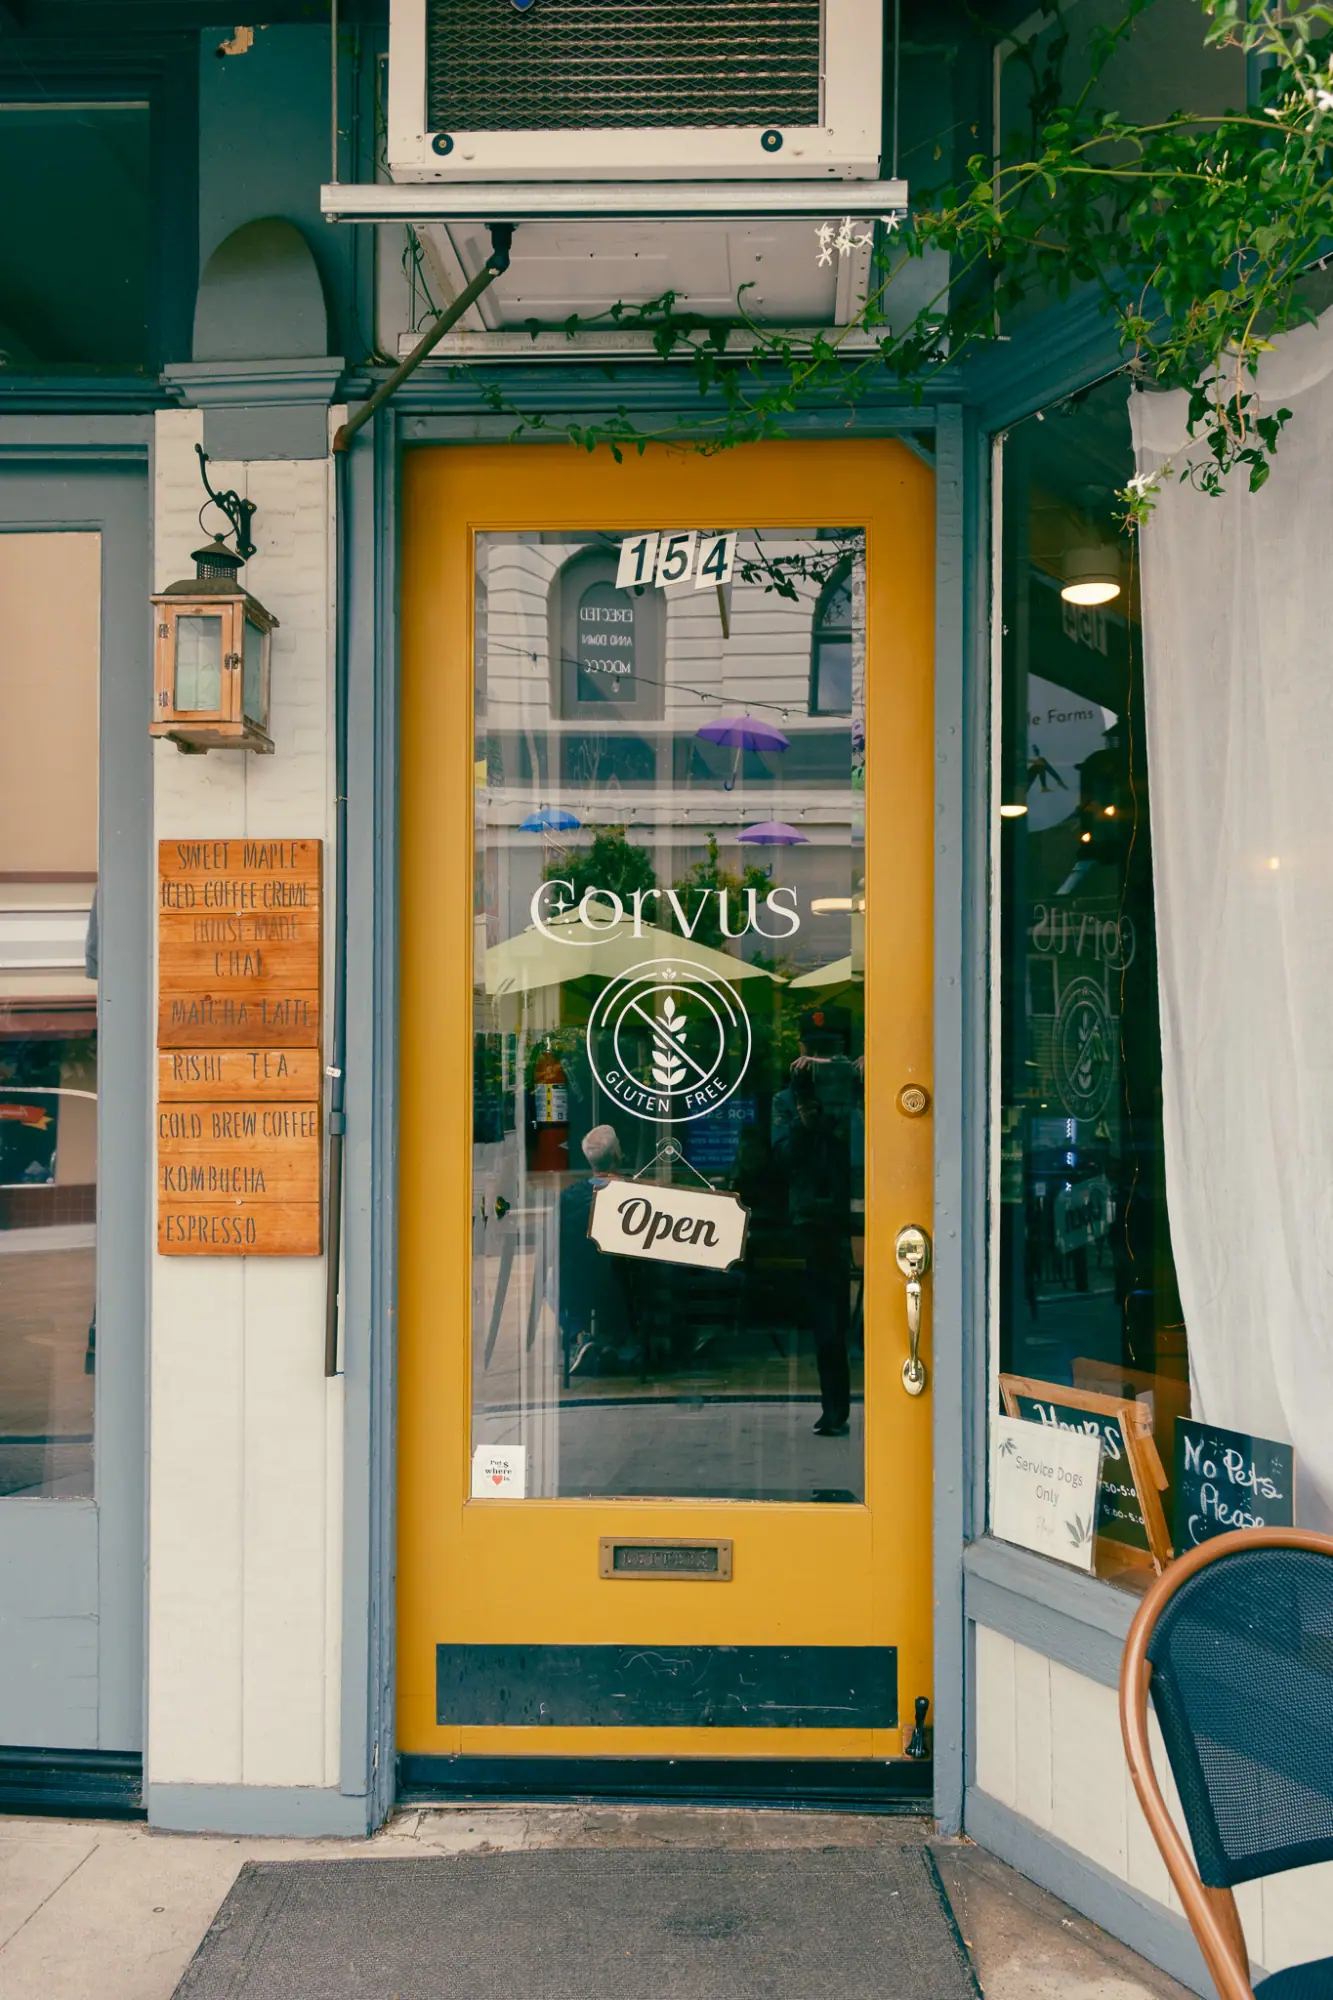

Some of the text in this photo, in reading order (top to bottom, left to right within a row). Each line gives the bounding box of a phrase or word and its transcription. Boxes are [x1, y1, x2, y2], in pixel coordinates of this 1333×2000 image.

[630, 535, 728, 582] 154
[1048, 709, 1094, 724] Farms
[177, 842, 298, 870] SWEET MAPLE
[162, 881, 309, 909] ICED COFFEE CREME
[530, 878, 800, 946] Corvus
[215, 948, 262, 977] CHAI
[172, 998, 310, 1026] MATCHA LATTE
[173, 1052, 288, 1081] RISHI TEA
[605, 1070, 670, 1112] GLUTEN
[685, 1077, 728, 1109] FREE
[159, 1111, 316, 1138] COLD BREW COFFEE
[164, 1166, 266, 1193] KOMBUCHA
[166, 1215, 256, 1245] ESPRESSO
[617, 1197, 720, 1250] Open
[1016, 1455, 1083, 1488] Service Dogs
[1183, 1434, 1283, 1499] No Pets
[1036, 1485, 1059, 1507] Only
